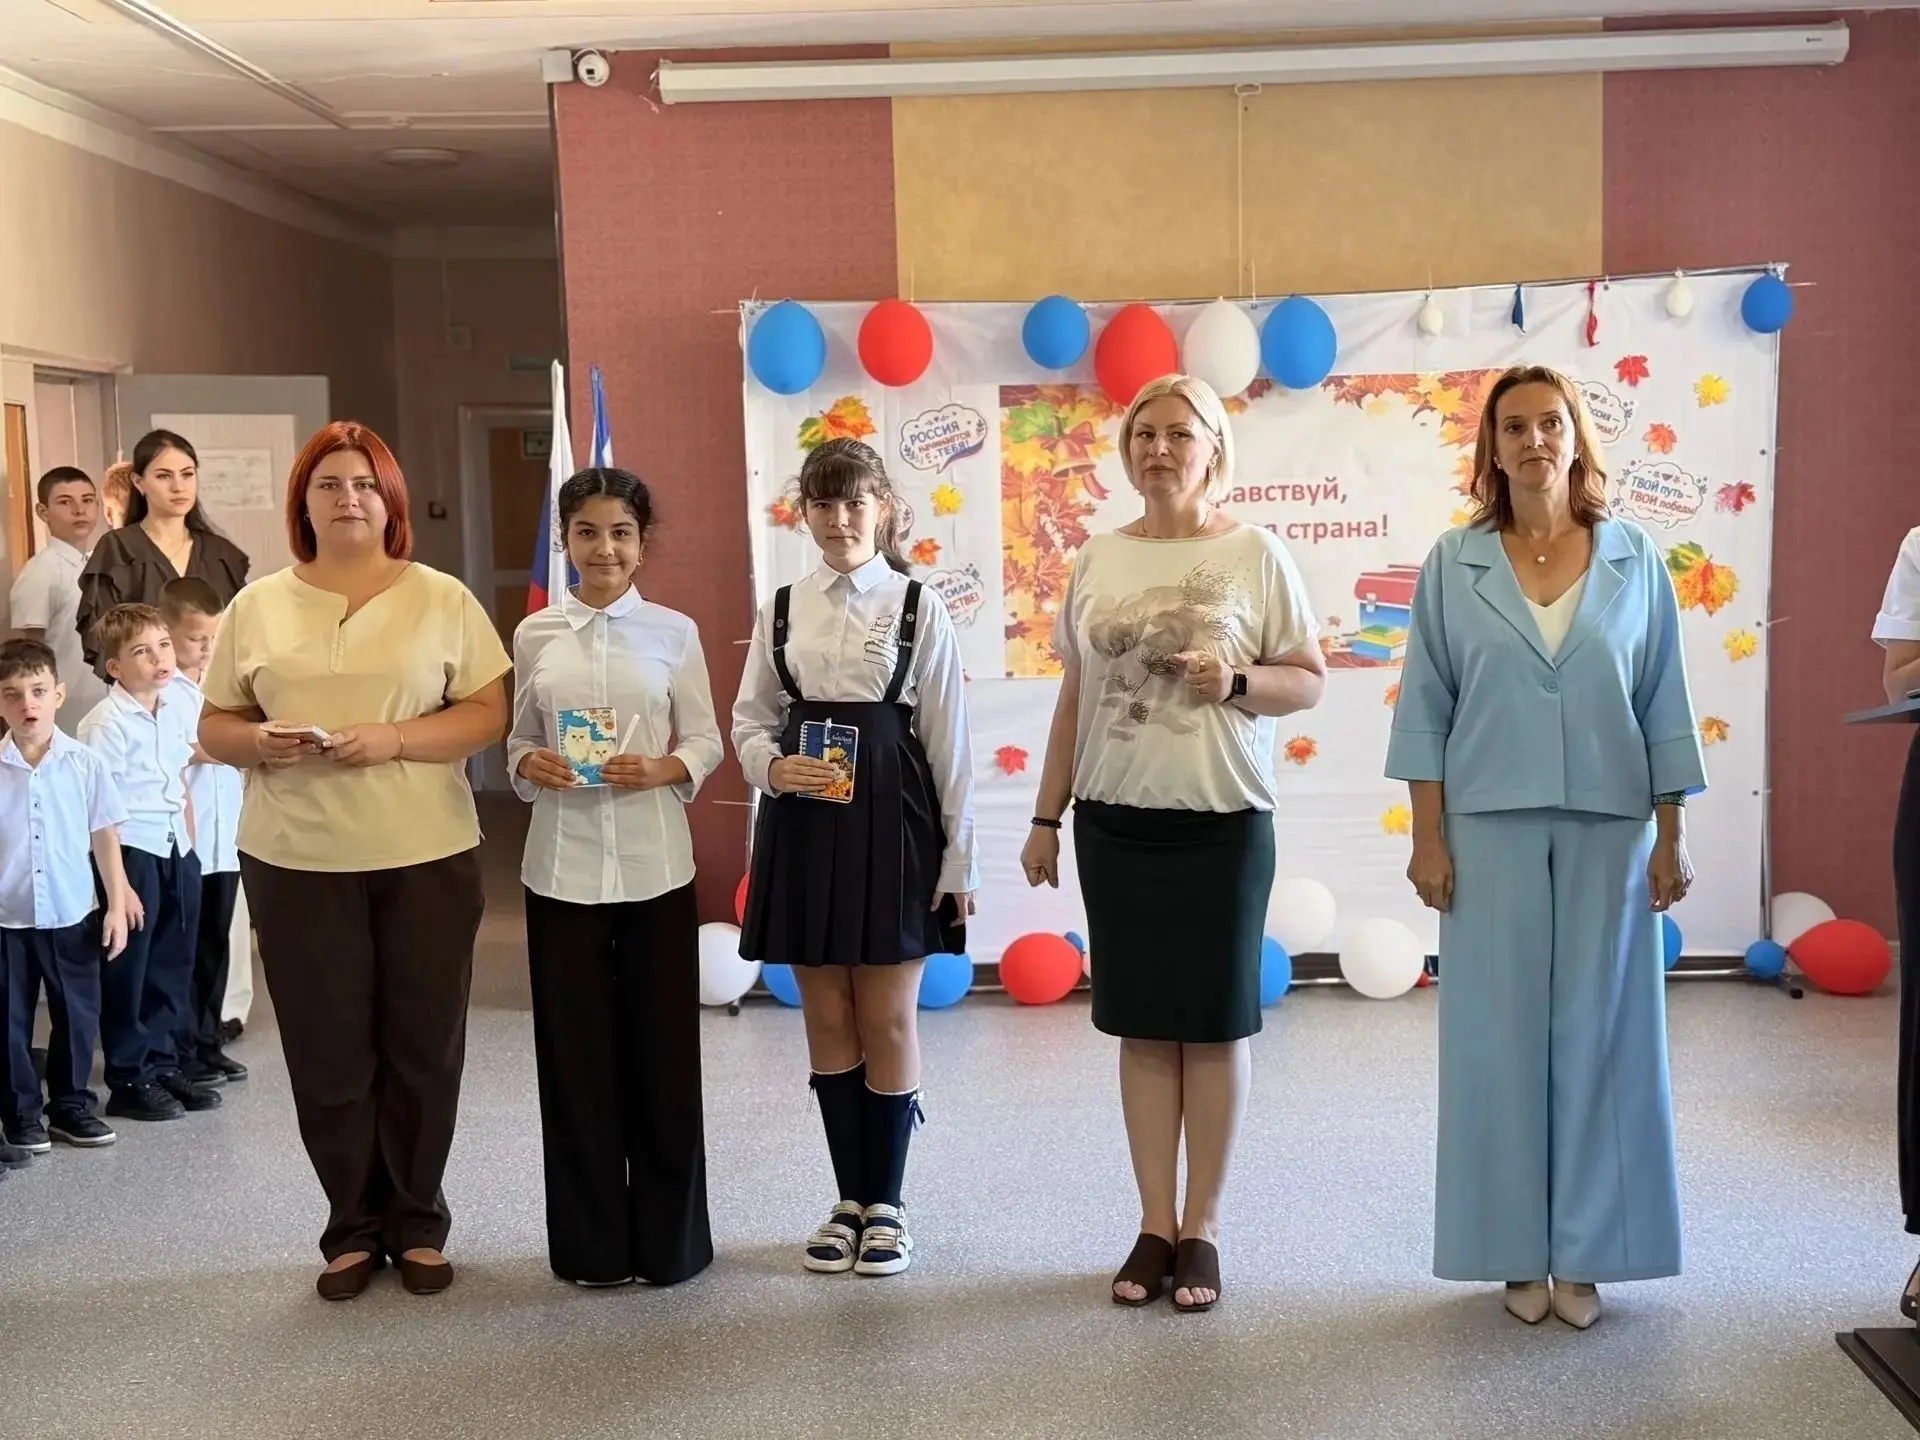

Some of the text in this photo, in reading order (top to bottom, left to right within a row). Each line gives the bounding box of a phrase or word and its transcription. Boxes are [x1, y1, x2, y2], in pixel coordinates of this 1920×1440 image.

[909, 420, 960, 446] РОССИЯ
[937, 440, 969, 458] ТЕБЯ!
[1631, 475, 1660, 493] ТВОЙ
[1659, 485, 1684, 499] путь
[1286, 514, 1388, 544] страна!
[944, 582, 973, 599] СИЛА
